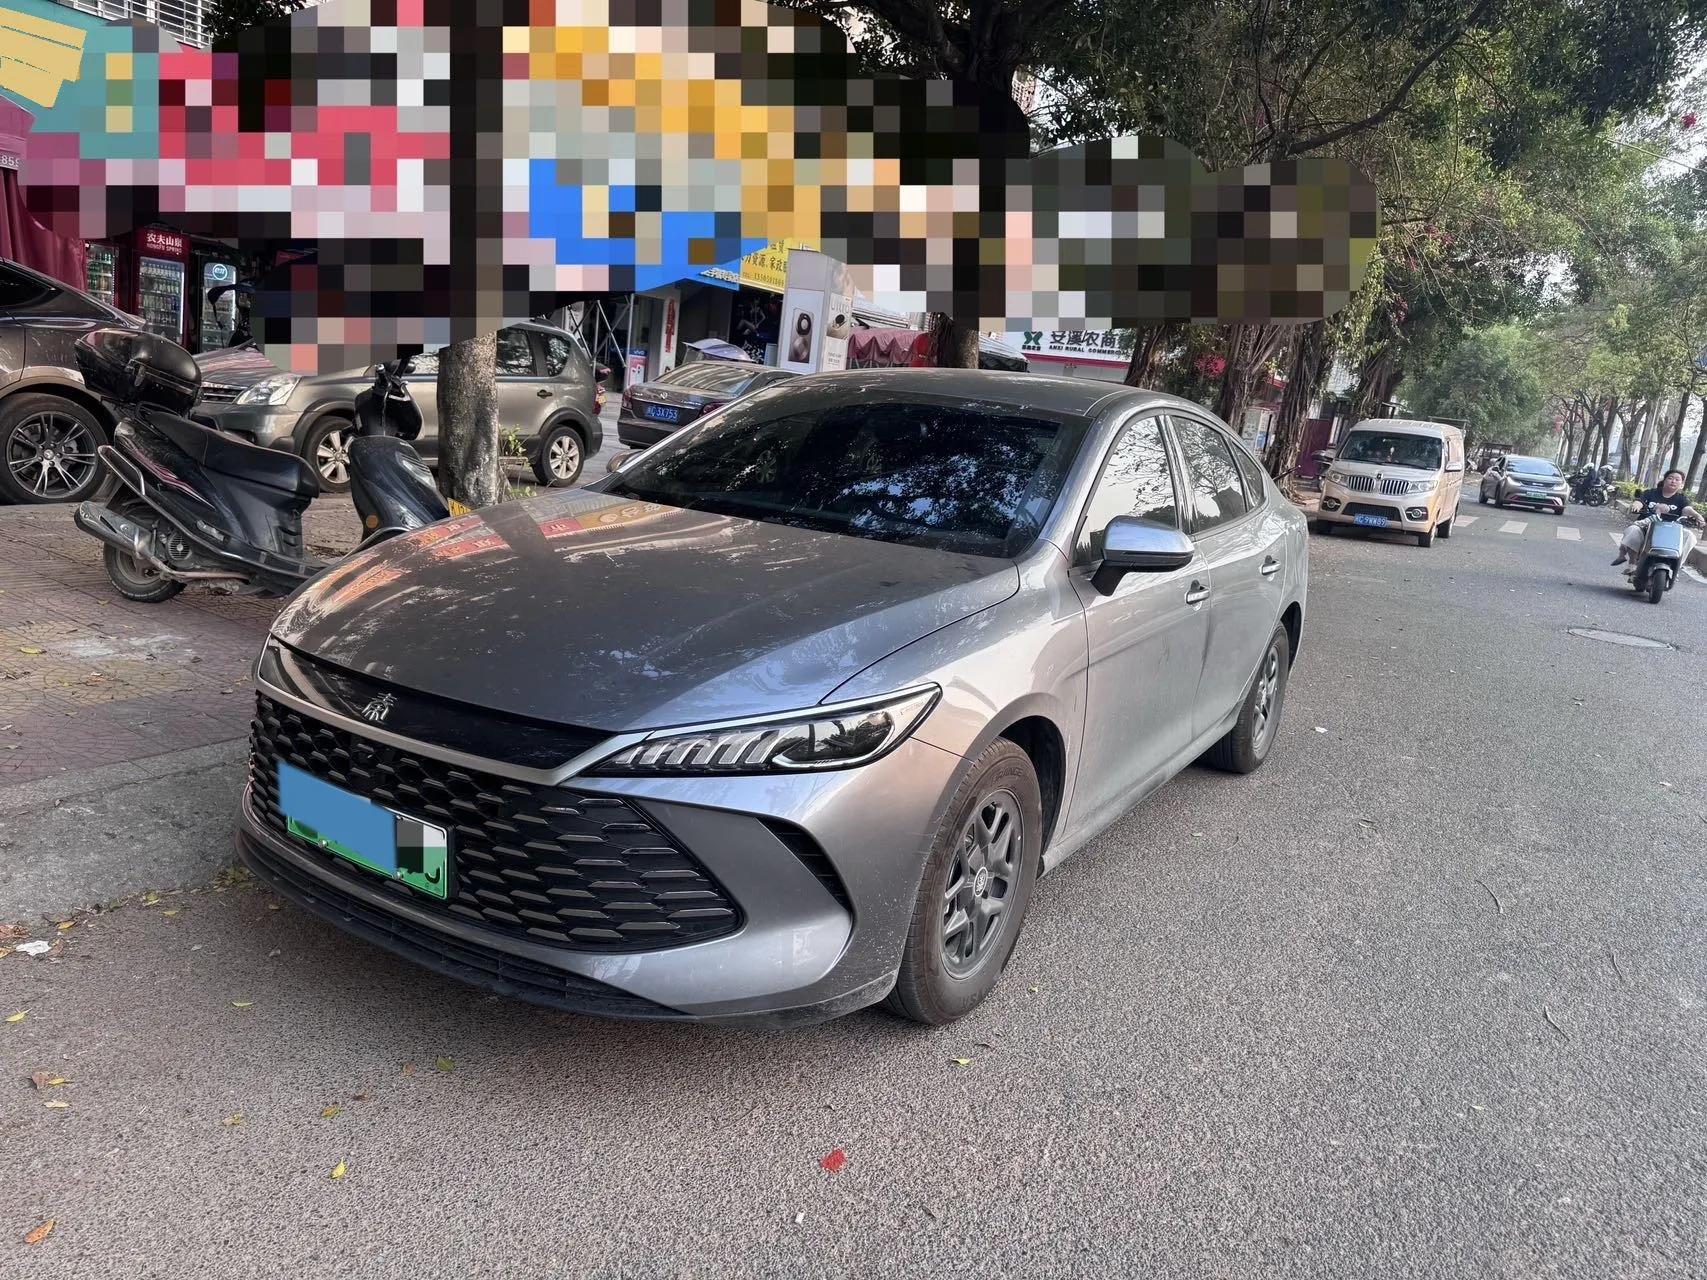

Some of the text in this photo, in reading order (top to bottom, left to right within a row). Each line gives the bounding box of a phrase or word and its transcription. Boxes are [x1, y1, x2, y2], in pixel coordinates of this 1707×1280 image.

[147, 232, 183, 248] 农夫山泉
[1050, 330, 1122, 349] 安溪农商
